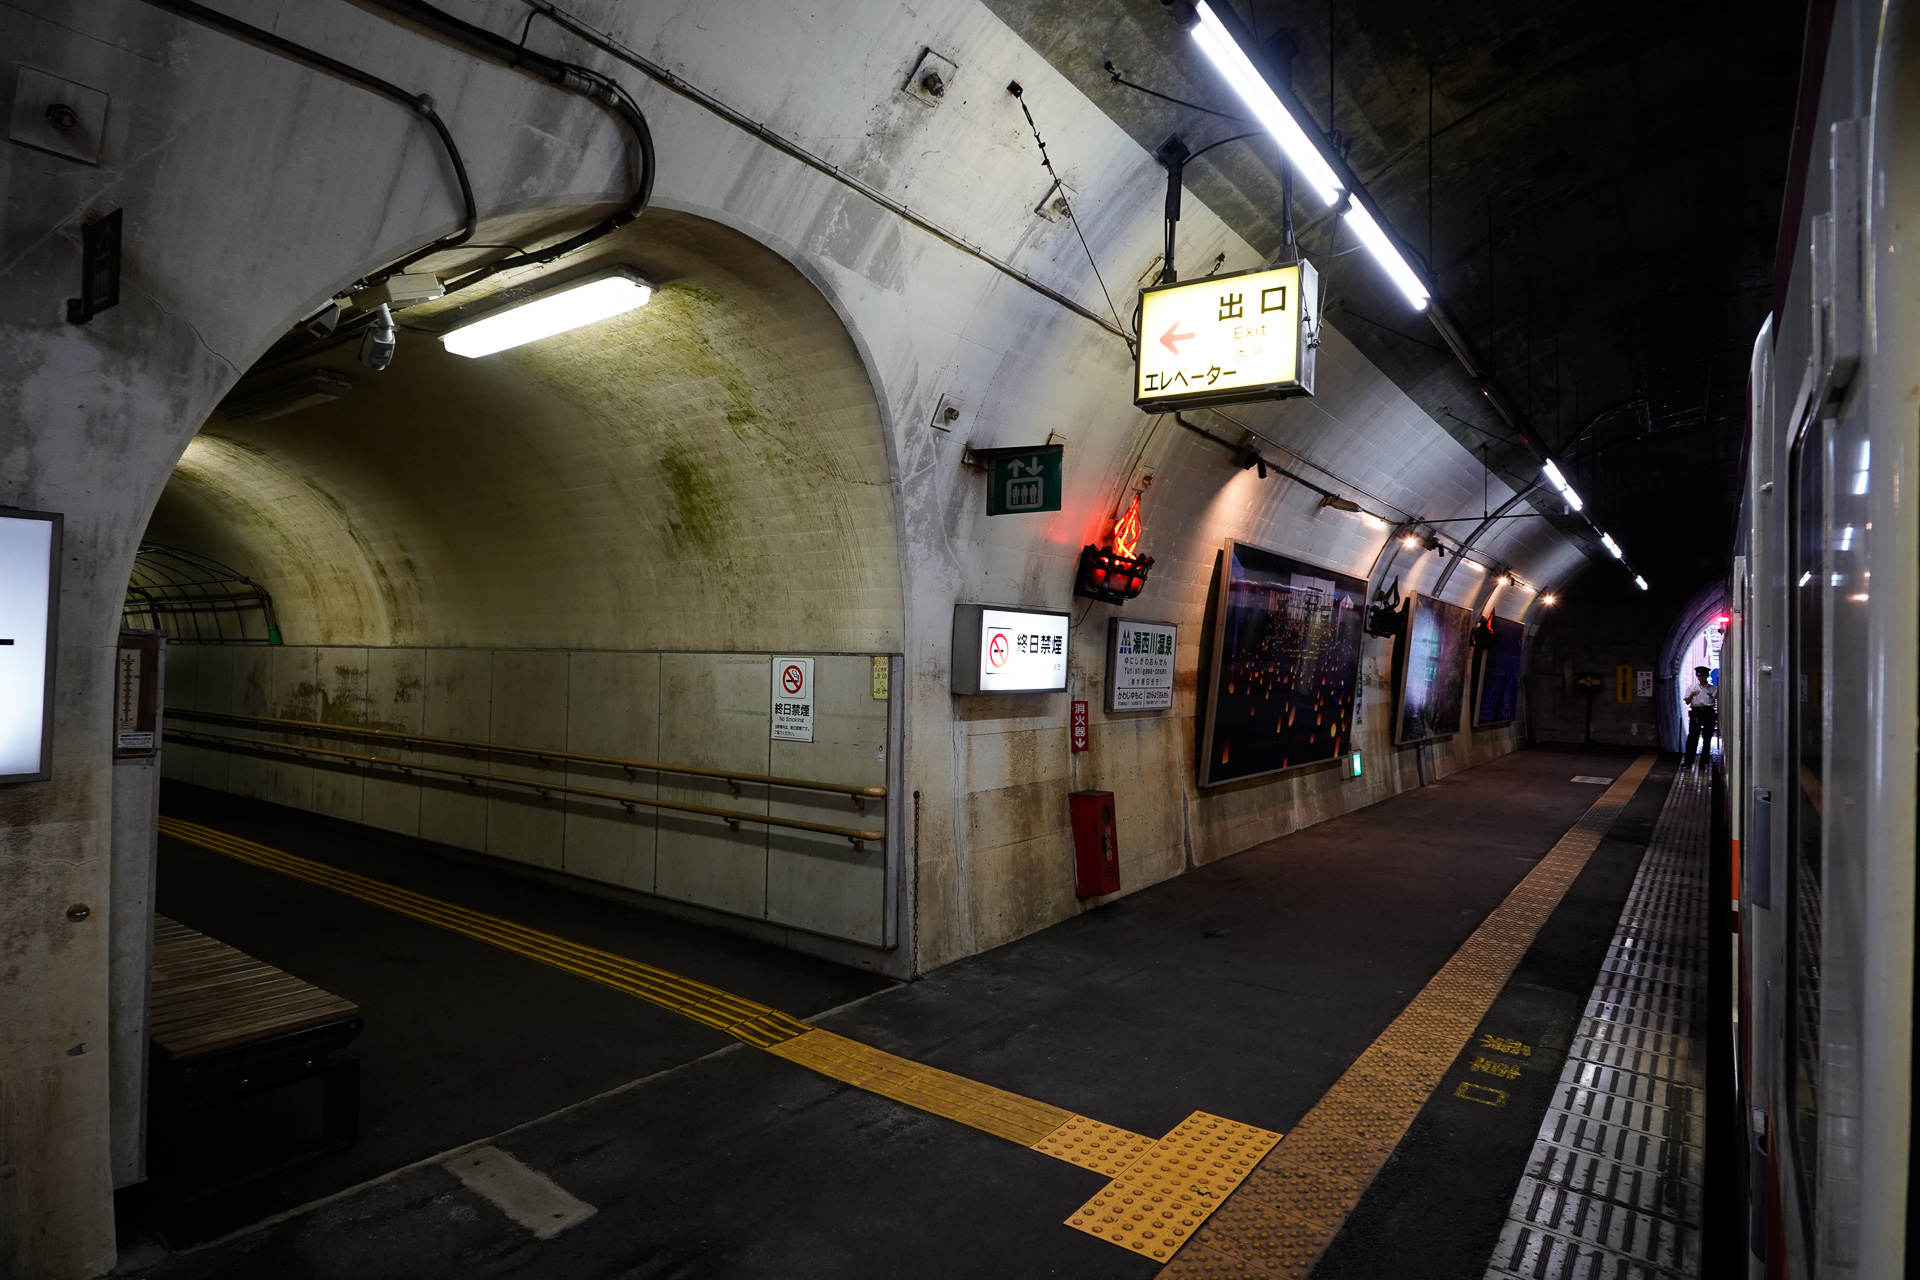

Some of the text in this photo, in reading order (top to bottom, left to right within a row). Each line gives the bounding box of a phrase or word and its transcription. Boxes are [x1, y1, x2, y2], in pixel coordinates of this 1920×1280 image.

[1219, 286, 1286, 321] 出口
[1234, 325, 1266, 339] Exit
[1144, 365, 1237, 392] エレベーター
[1017, 633, 1062, 655] 終日禁煙
[1132, 631, 1173, 656] 湯西川温泉
[1124, 657, 1168, 666] ゆにしがわおんせん
[1124, 667, 1167, 675] Yunishigawa-onsen
[774, 702, 810, 717] 終日禁煙
[786, 716, 805, 724] Smoking
[1075, 703, 1086, 738] 消火器
